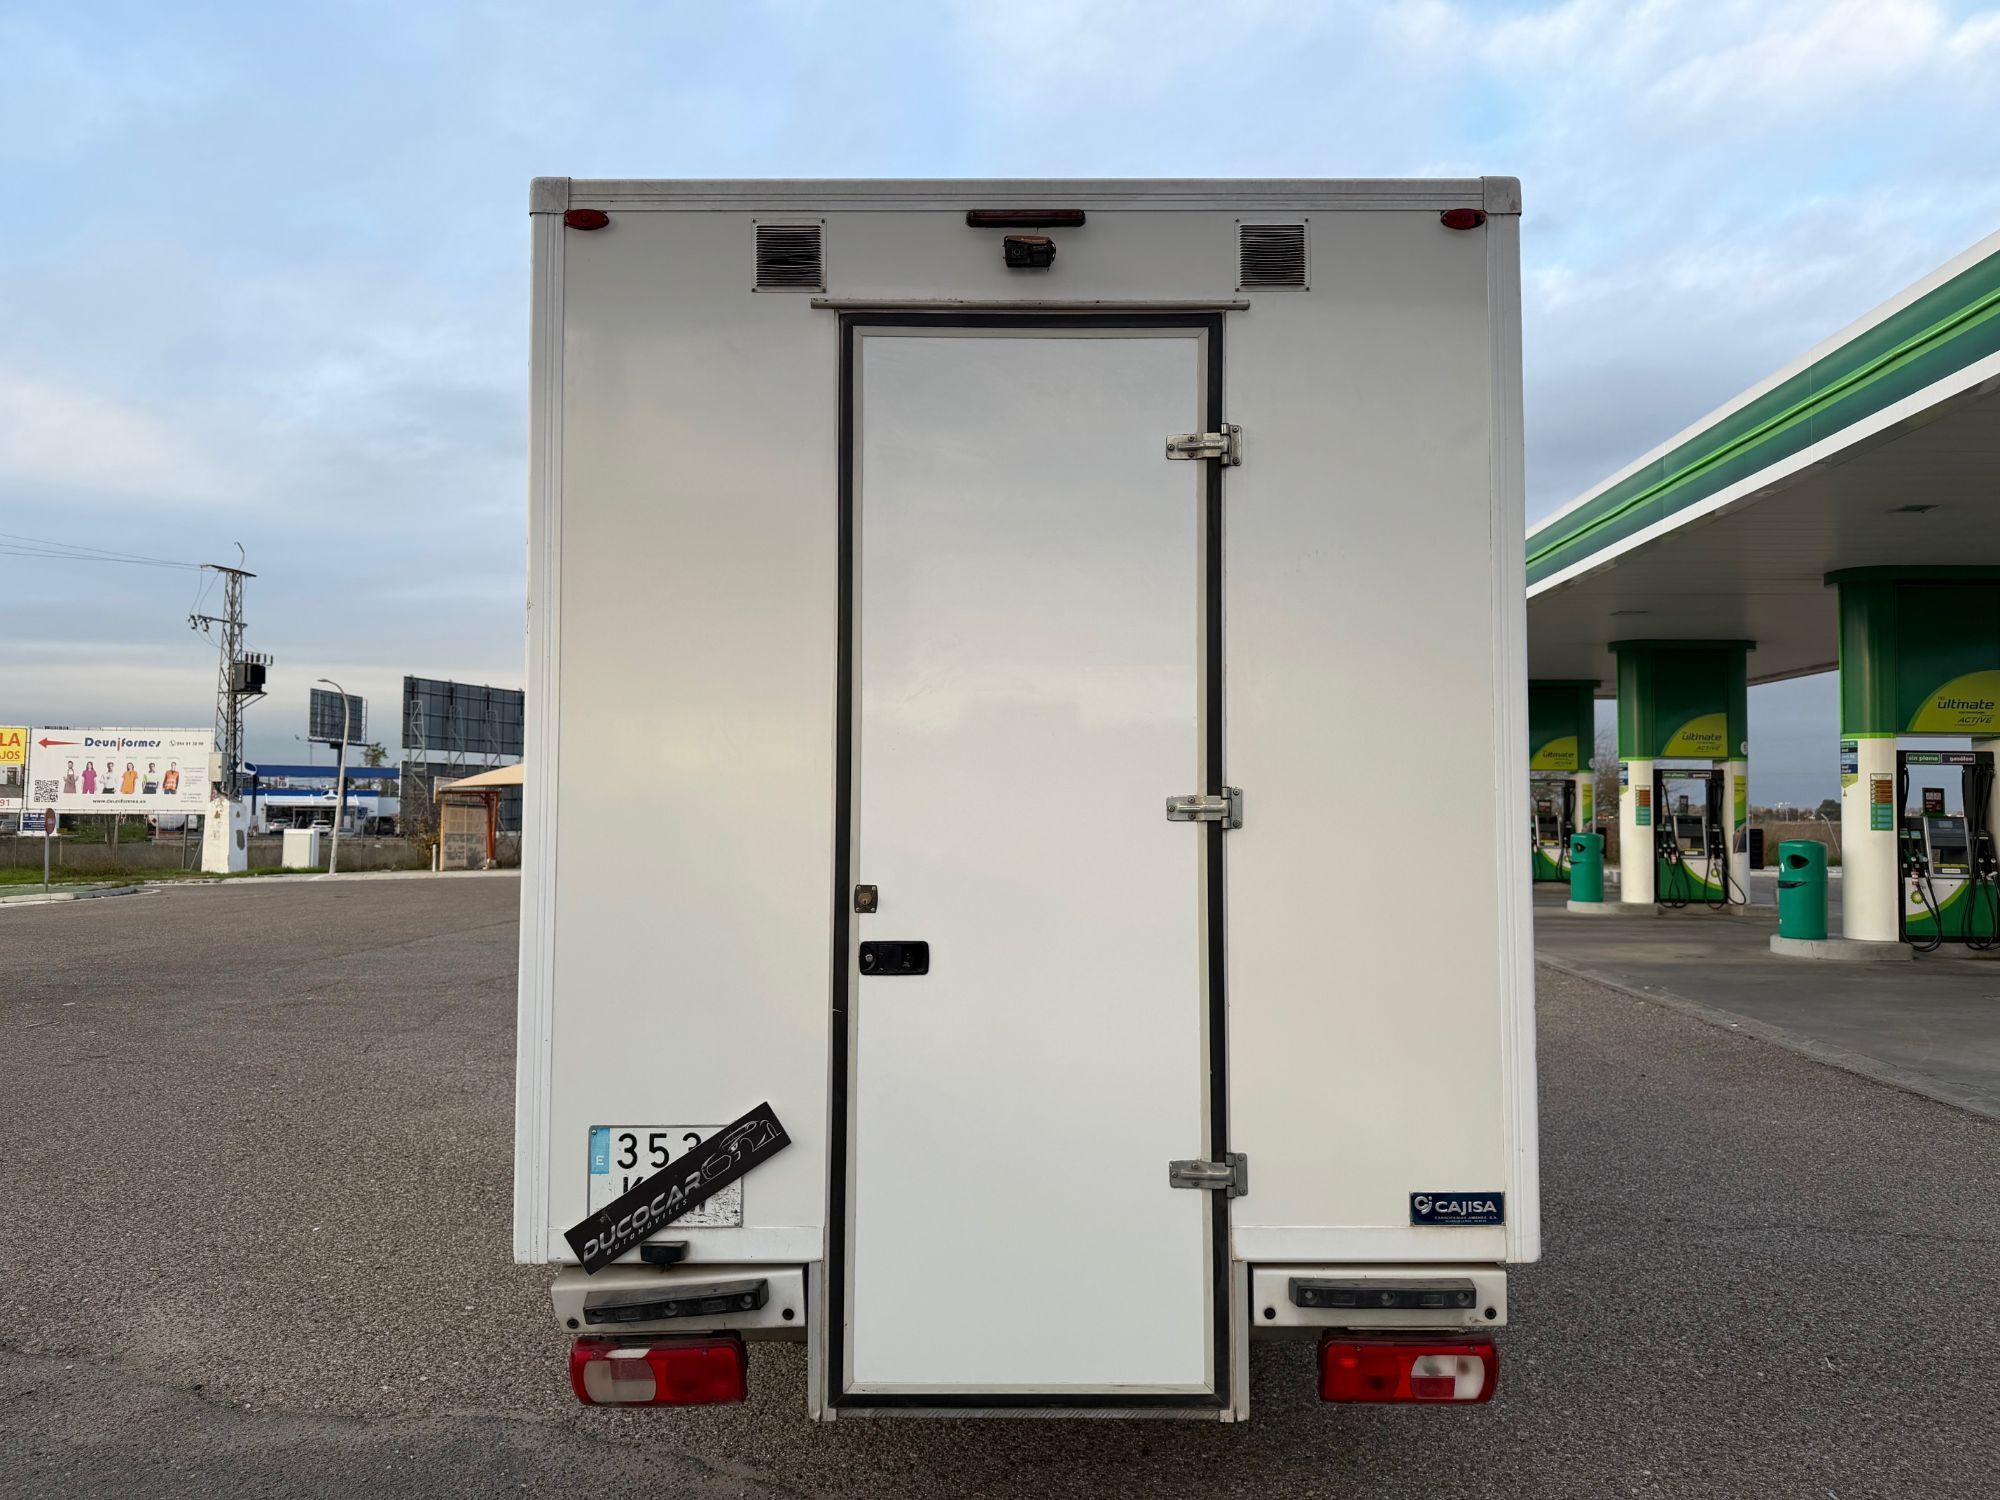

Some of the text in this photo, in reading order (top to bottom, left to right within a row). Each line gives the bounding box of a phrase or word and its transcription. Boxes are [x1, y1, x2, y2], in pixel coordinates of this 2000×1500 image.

[1937, 698, 1995, 710] ultimate
[1957, 715, 1993, 724] ACTIVE
[84, 737, 162, 752] Deuniformes
[1681, 732, 1722, 742] ultimate
[616, 1132, 703, 1169] 353
[595, 1155, 605, 1166] E
[1434, 1200, 1497, 1216] CAJISA
[583, 1171, 701, 1262] DUCOCAR
[606, 1198, 687, 1255] AUTOMOVILES
